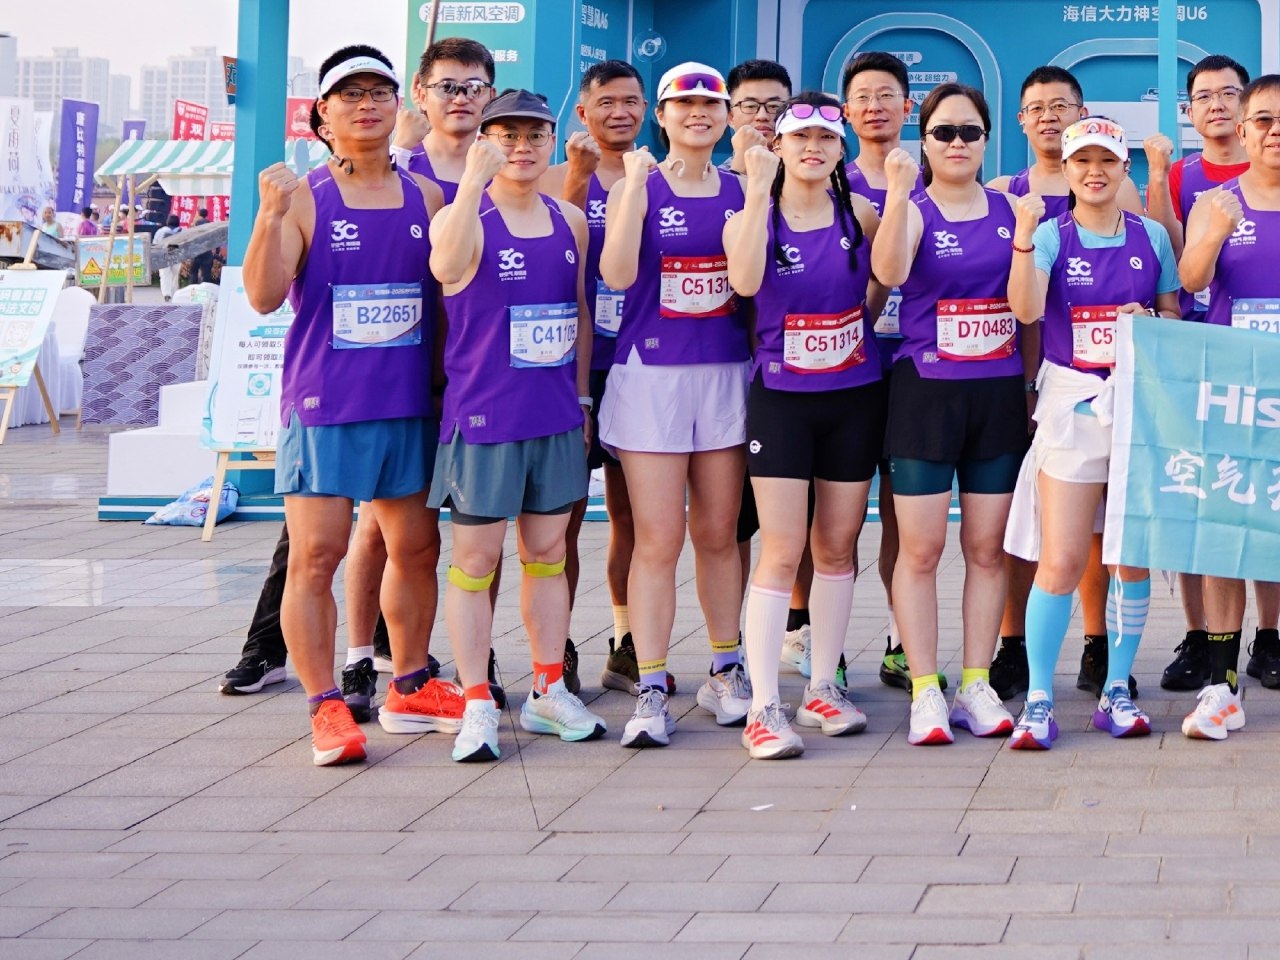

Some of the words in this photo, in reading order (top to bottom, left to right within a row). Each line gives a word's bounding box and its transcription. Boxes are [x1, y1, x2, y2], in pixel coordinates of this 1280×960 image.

[681, 276, 735, 296] C5131
[357, 304, 417, 324] B22651
[958, 318, 1013, 338] D70483
[1091, 327, 1117, 345] C5
[805, 326, 859, 352] C51314
